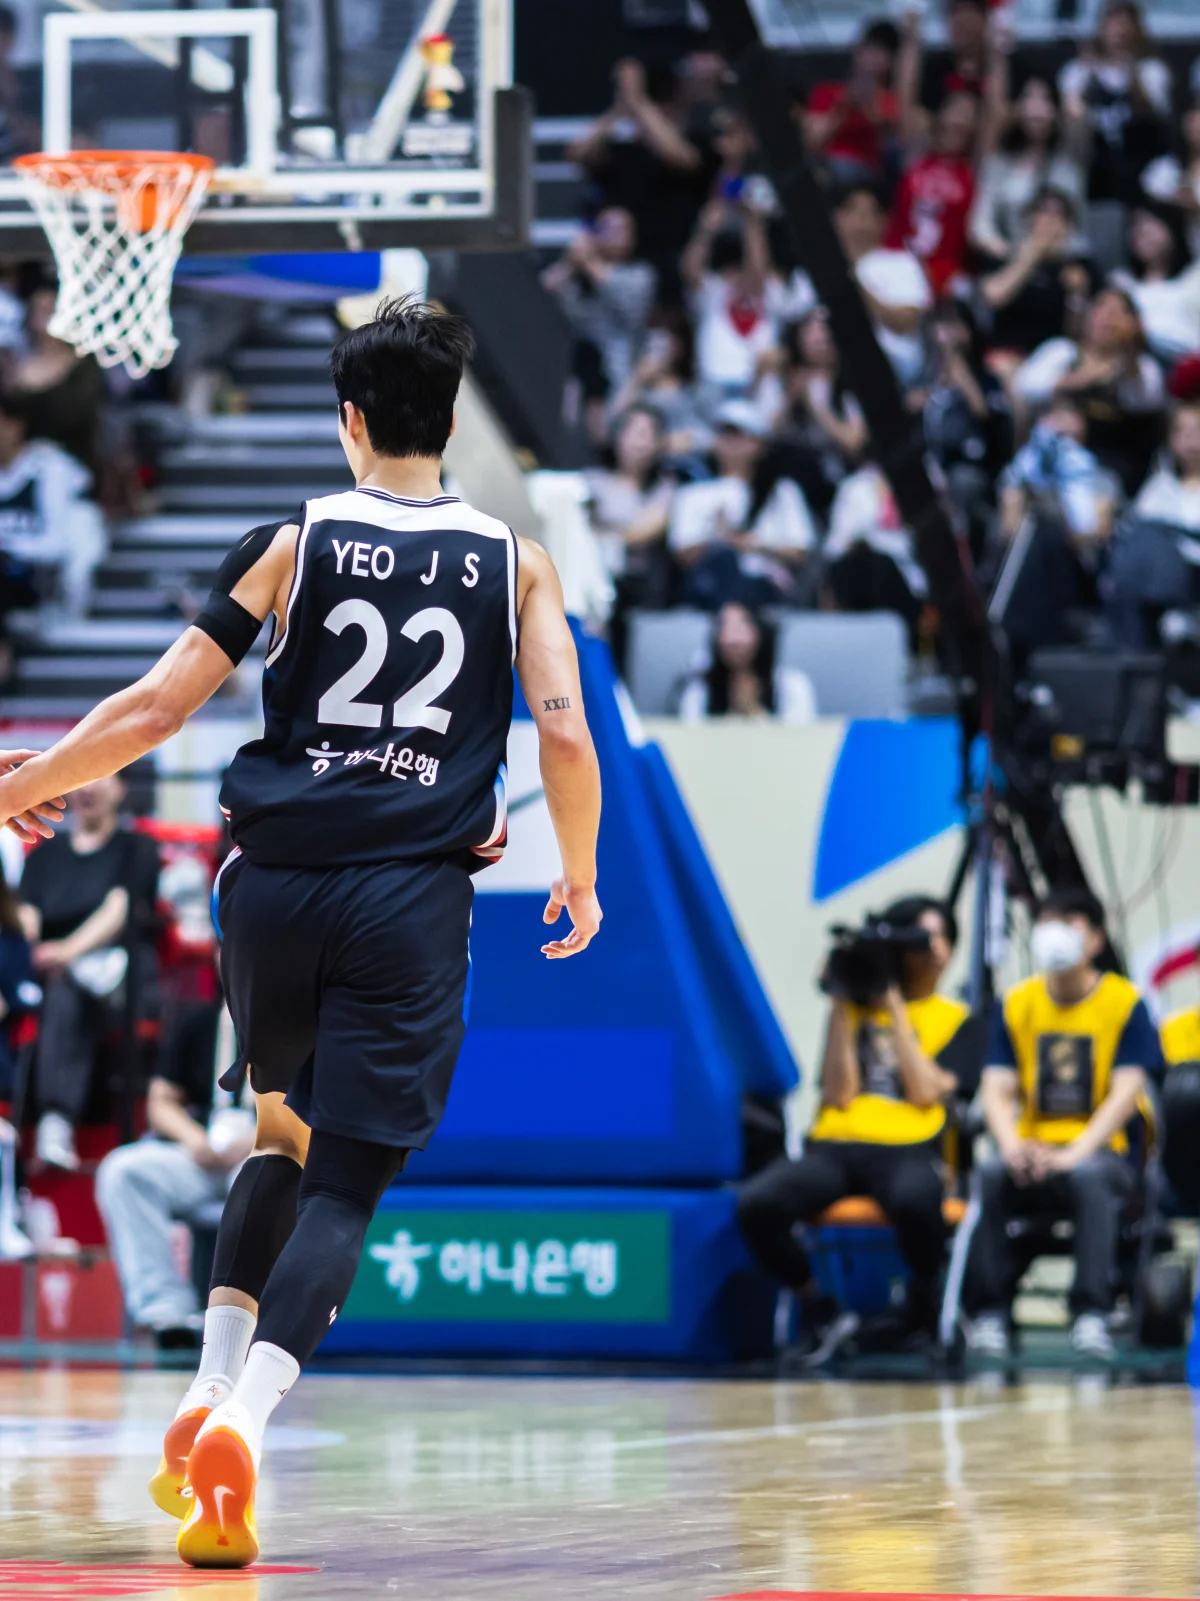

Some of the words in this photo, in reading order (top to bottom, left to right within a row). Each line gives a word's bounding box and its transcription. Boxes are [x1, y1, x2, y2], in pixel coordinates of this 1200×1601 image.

[331, 539, 395, 581] YEO
[419, 550, 439, 586] J
[461, 552, 481, 588] S
[317, 598, 465, 735] 22
[542, 696, 571, 712] XXII
[343, 742, 440, 787] 하나은행
[438, 1238, 619, 1296] 하나은행
